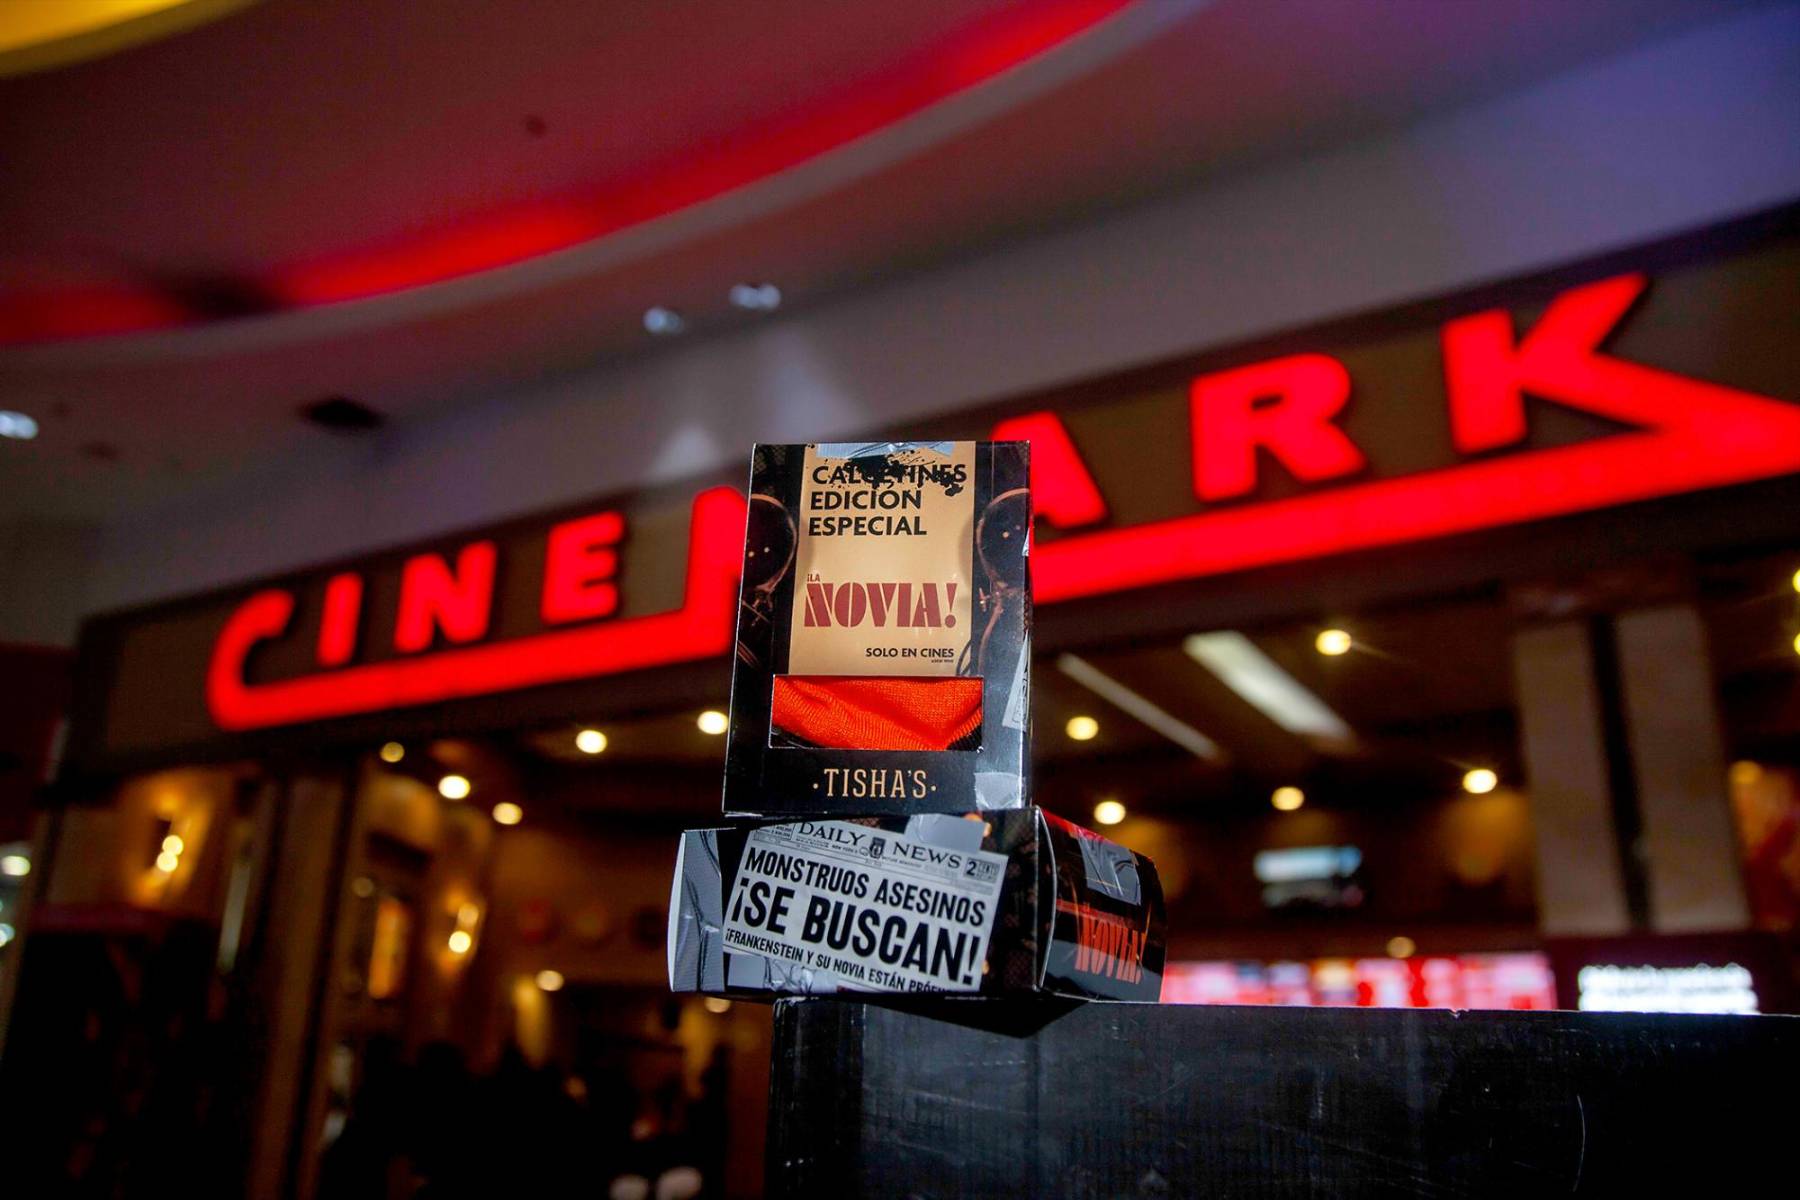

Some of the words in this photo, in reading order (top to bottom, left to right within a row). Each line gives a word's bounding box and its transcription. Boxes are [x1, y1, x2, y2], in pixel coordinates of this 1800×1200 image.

[811, 482, 922, 510] EDICIÓN
[808, 516, 927, 536] ESPECIAL
[804, 582, 957, 628] NOVIA!
[865, 648, 898, 657] SOLO
[901, 648, 917, 657] EN
[920, 648, 954, 658] CINES
[798, 821, 866, 846] DAILY
[893, 841, 962, 869] NEWS
[966, 861, 977, 876] 2
[744, 847, 870, 899] MONSTRUOS
[873, 878, 986, 927] ASESINOS
[731, 877, 795, 935] ¡SE
[801, 895, 981, 985] BUSCAN!
[725, 928, 804, 962] ¡FRANKENSTEIN
[807, 950, 815, 965] Y
[816, 954, 831, 969] SU
[833, 959, 865, 979] NOVIA
[868, 968, 906, 991] ESTÁN
